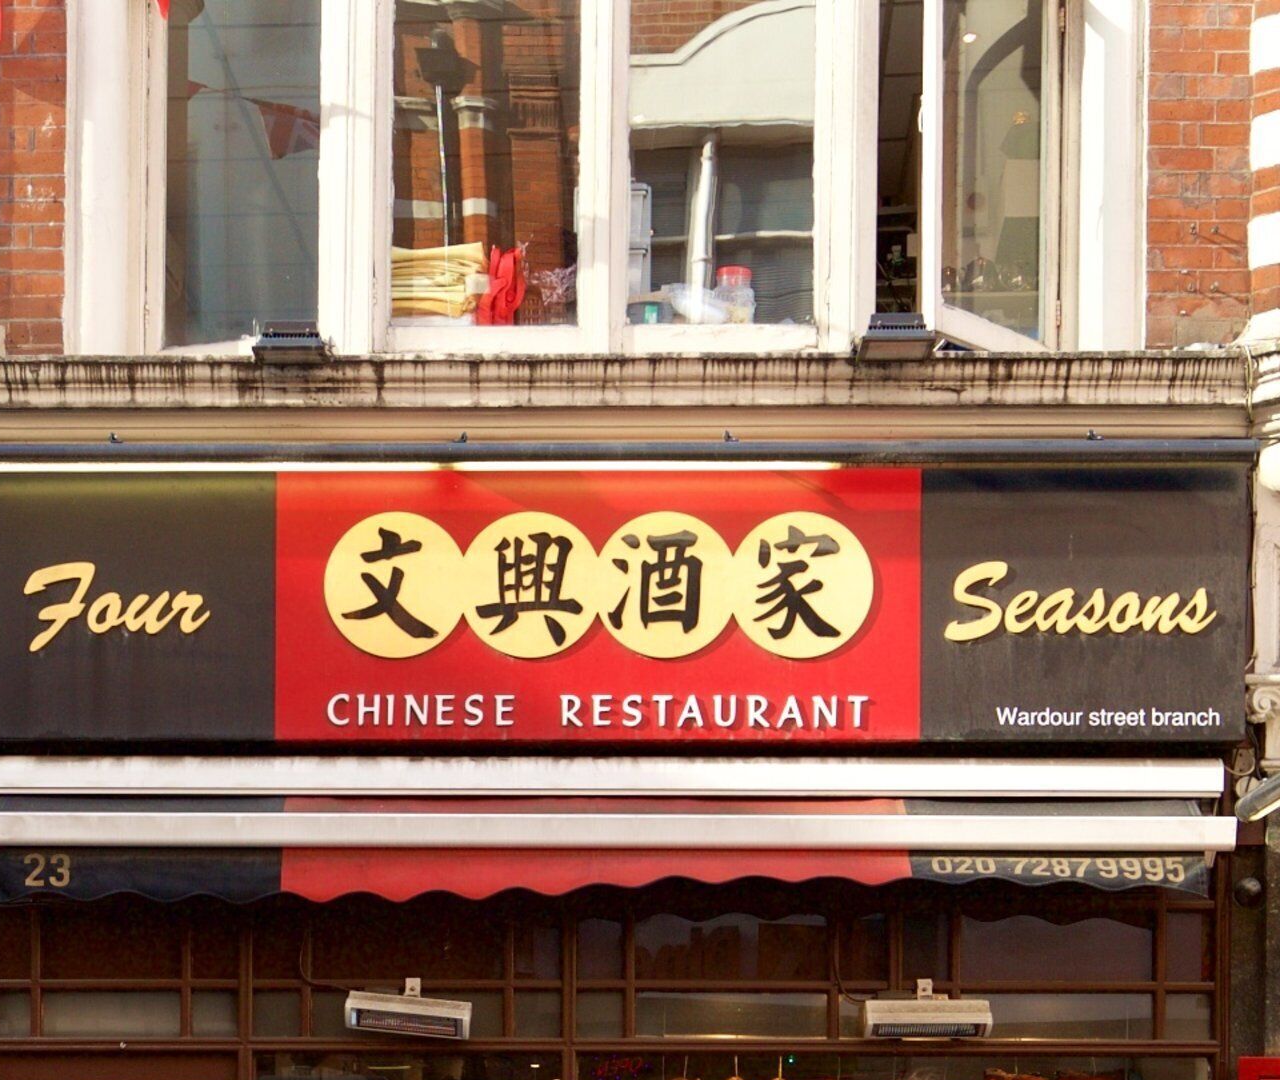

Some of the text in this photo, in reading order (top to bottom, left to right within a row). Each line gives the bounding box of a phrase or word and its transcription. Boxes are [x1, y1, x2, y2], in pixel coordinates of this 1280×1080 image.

[23, 561, 211, 652] Four
[341, 524, 844, 647] 文興酒家
[943, 560, 1218, 643] Seasons
[327, 694, 870, 729] CHINESE RESTAURANT
[996, 706, 1222, 728] Wardour street branch
[24, 853, 72, 889] 23
